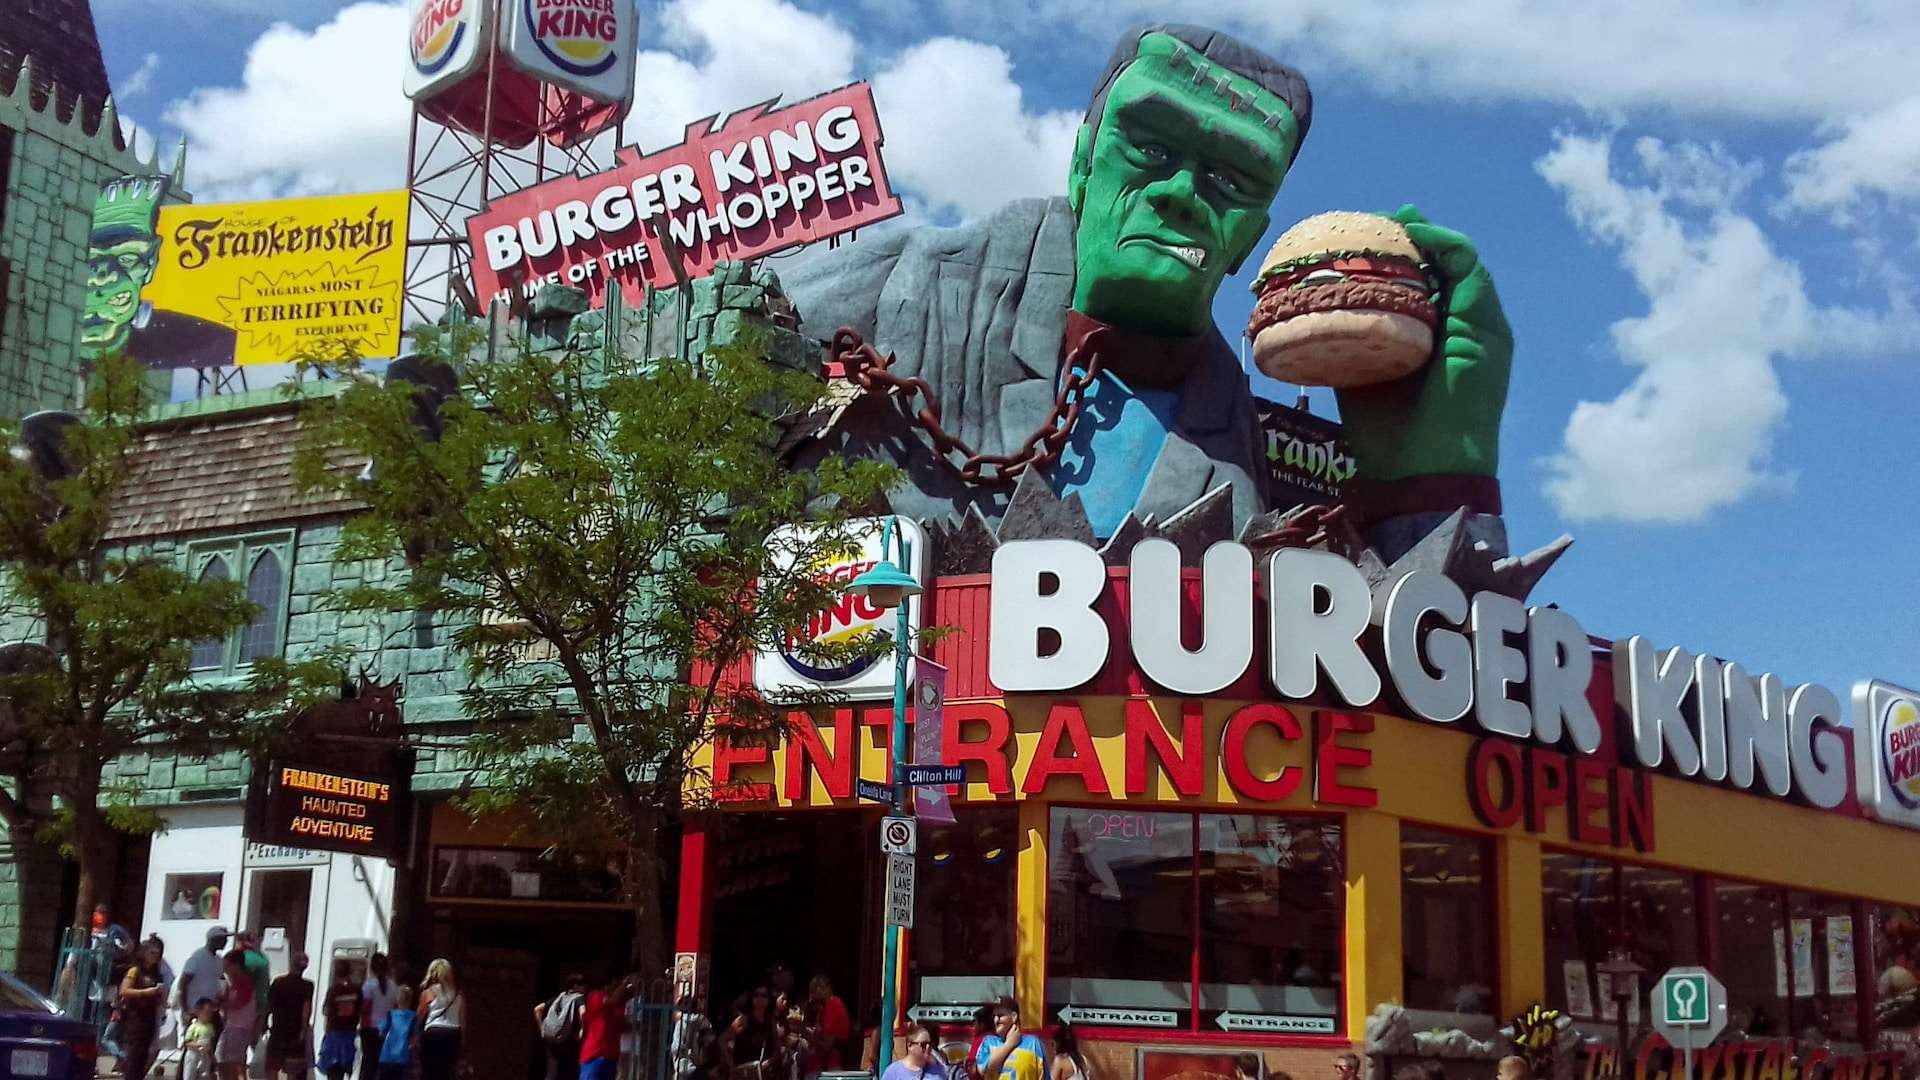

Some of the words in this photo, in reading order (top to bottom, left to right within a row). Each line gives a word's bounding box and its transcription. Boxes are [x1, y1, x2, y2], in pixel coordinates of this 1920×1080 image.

[537, 9, 617, 42] KING
[484, 163, 702, 272] BURGER
[709, 105, 862, 192] KING
[175, 205, 394, 269] Frankenstein
[493, 271, 560, 305] HME
[567, 257, 598, 284] OF
[604, 242, 649, 271] THE
[656, 155, 873, 248] WHOPPER
[320, 279, 364, 293] MOST
[241, 298, 385, 324] TERRIFYING
[295, 322, 370, 336] EXPERIENCE
[1271, 468, 1294, 485] THE
[988, 538, 1601, 754] BURGER
[1626, 634, 1848, 809] KING
[712, 700, 1379, 808] ENTRANCE
[1891, 746, 1920, 785] KI
[281, 767, 391, 802] FRANKENSTEIN'S
[908, 769, 942, 784] Clifton
[944, 767, 963, 782] Hill
[1470, 736, 1655, 853] OPEN
[301, 795, 367, 819] HAUNTED
[289, 815, 375, 842] ADVENTURE
[1087, 813, 1156, 838] OPEN
[893, 859, 913, 876] RIGHT
[894, 876, 911, 891] LANE
[893, 891, 911, 908] MUST
[893, 907, 911, 923] TURN
[918, 1009, 980, 1018] ENTRA
[1071, 1009, 1173, 1024] ENTRANCE
[1228, 1016, 1330, 1030] ENTRANCE
